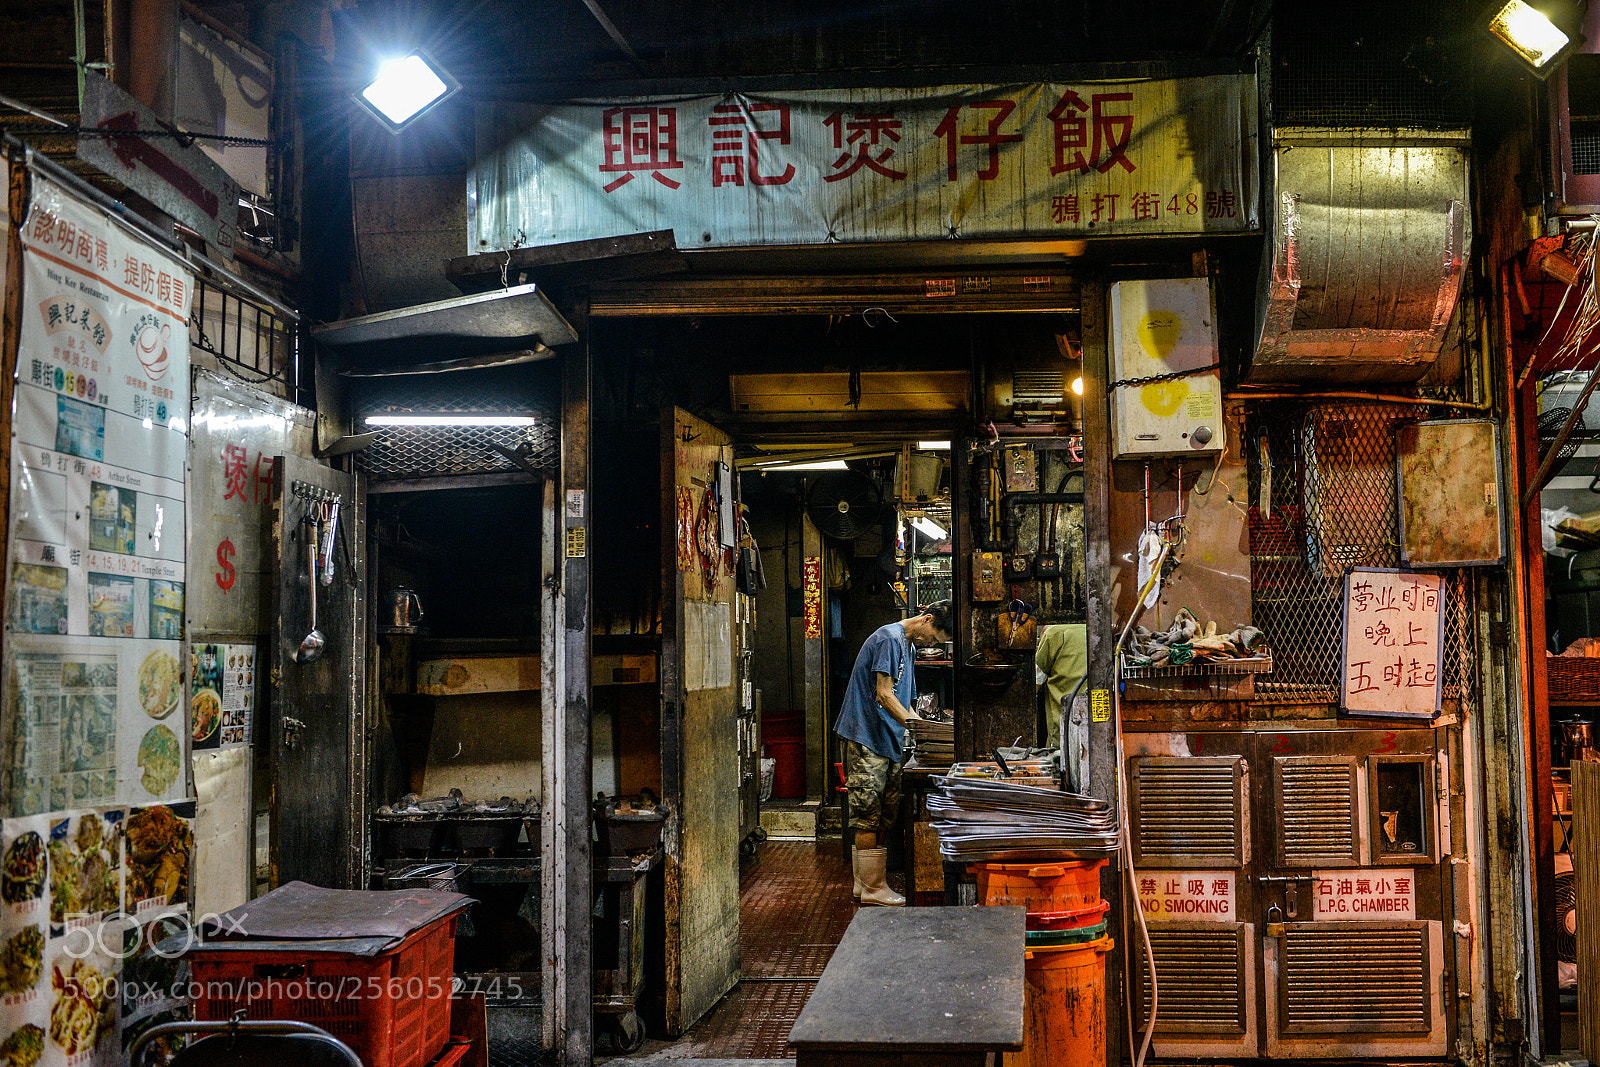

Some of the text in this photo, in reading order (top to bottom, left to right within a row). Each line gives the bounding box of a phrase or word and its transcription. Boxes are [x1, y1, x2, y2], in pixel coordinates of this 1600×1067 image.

[598, 89, 1137, 194] 興記煲仔飯
[1364, 620, 1428, 647] 晚上
[1349, 655, 1437, 695] 五时起
[1273, 734, 1294, 752] 2
[1374, 731, 1398, 754] 3
[1140, 878, 1230, 897] 禁止吸煙
[1316, 877, 1411, 896] 石油氣小室
[1140, 899, 1229, 914] NO SMOKING
[1318, 898, 1410, 914] L.P.G. CHAMBER
